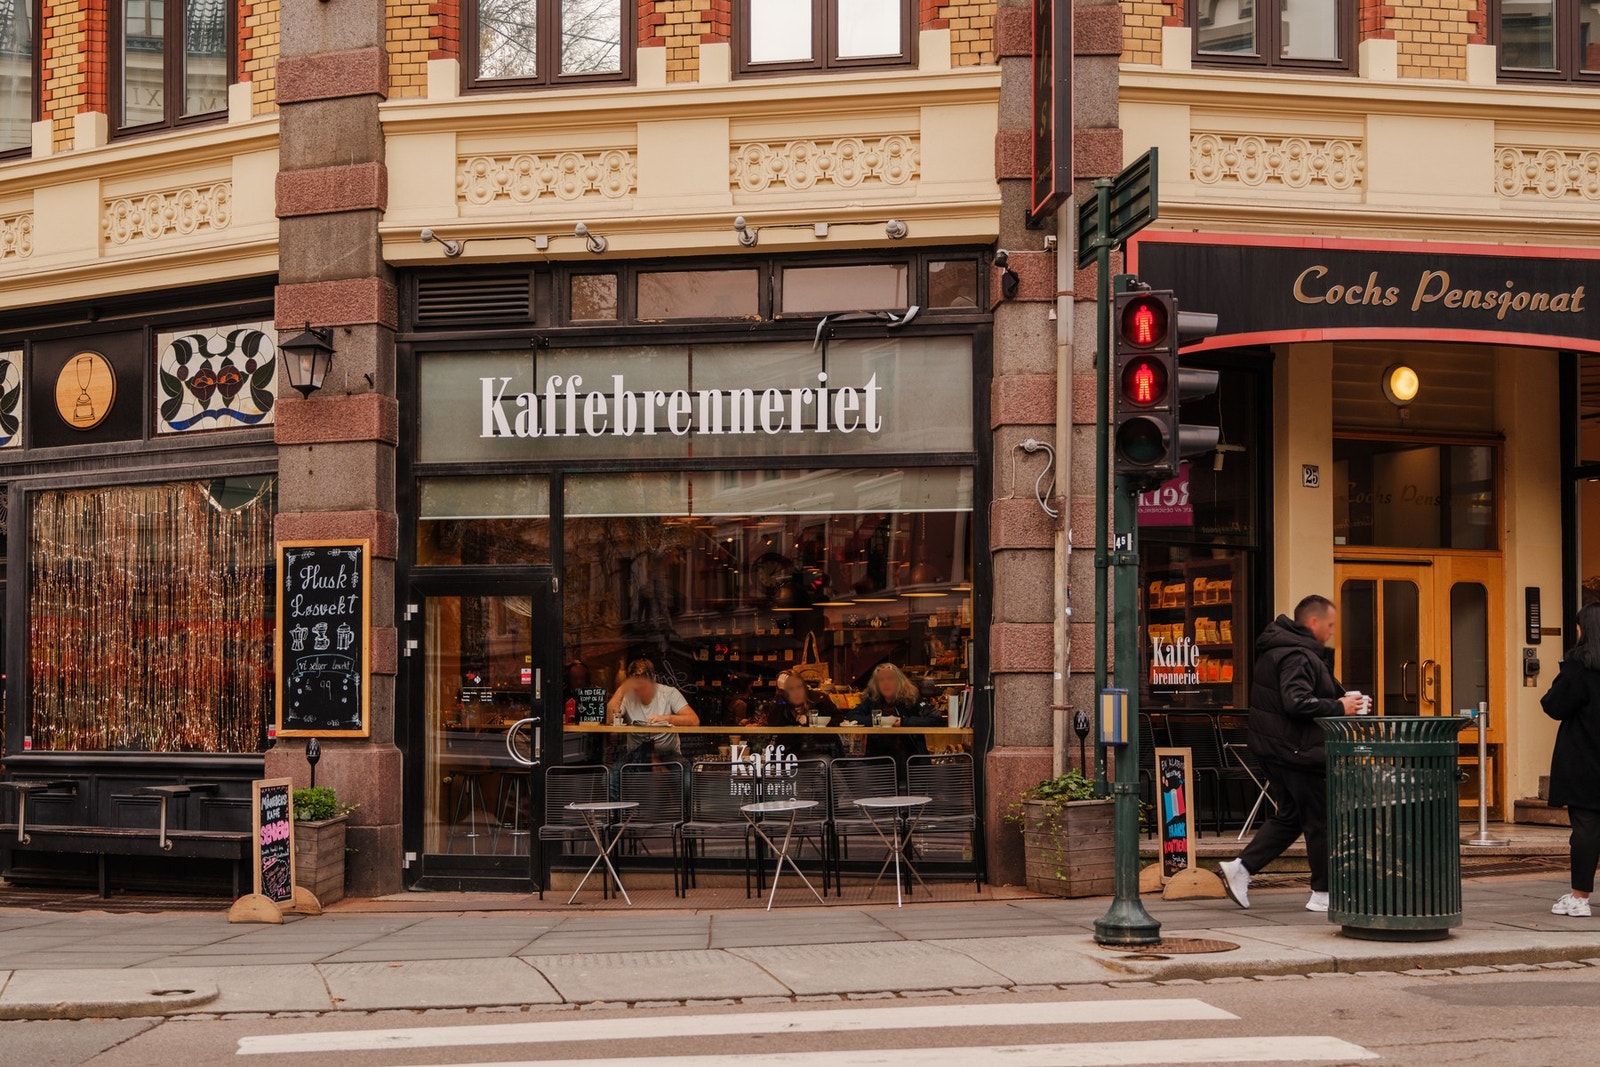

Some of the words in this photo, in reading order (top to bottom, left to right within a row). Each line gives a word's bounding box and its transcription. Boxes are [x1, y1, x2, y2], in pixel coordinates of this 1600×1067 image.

[1293, 265, 1400, 306] Cochs
[1410, 269, 1586, 321] Pensjonat
[478, 371, 882, 438] Kaffebrenneriet
[1305, 467, 1319, 485] 25
[299, 563, 348, 590] Husk
[1153, 637, 1200, 667] Kaffe
[1153, 670, 1200, 685] brenneriet
[730, 744, 799, 778] Kaffe
